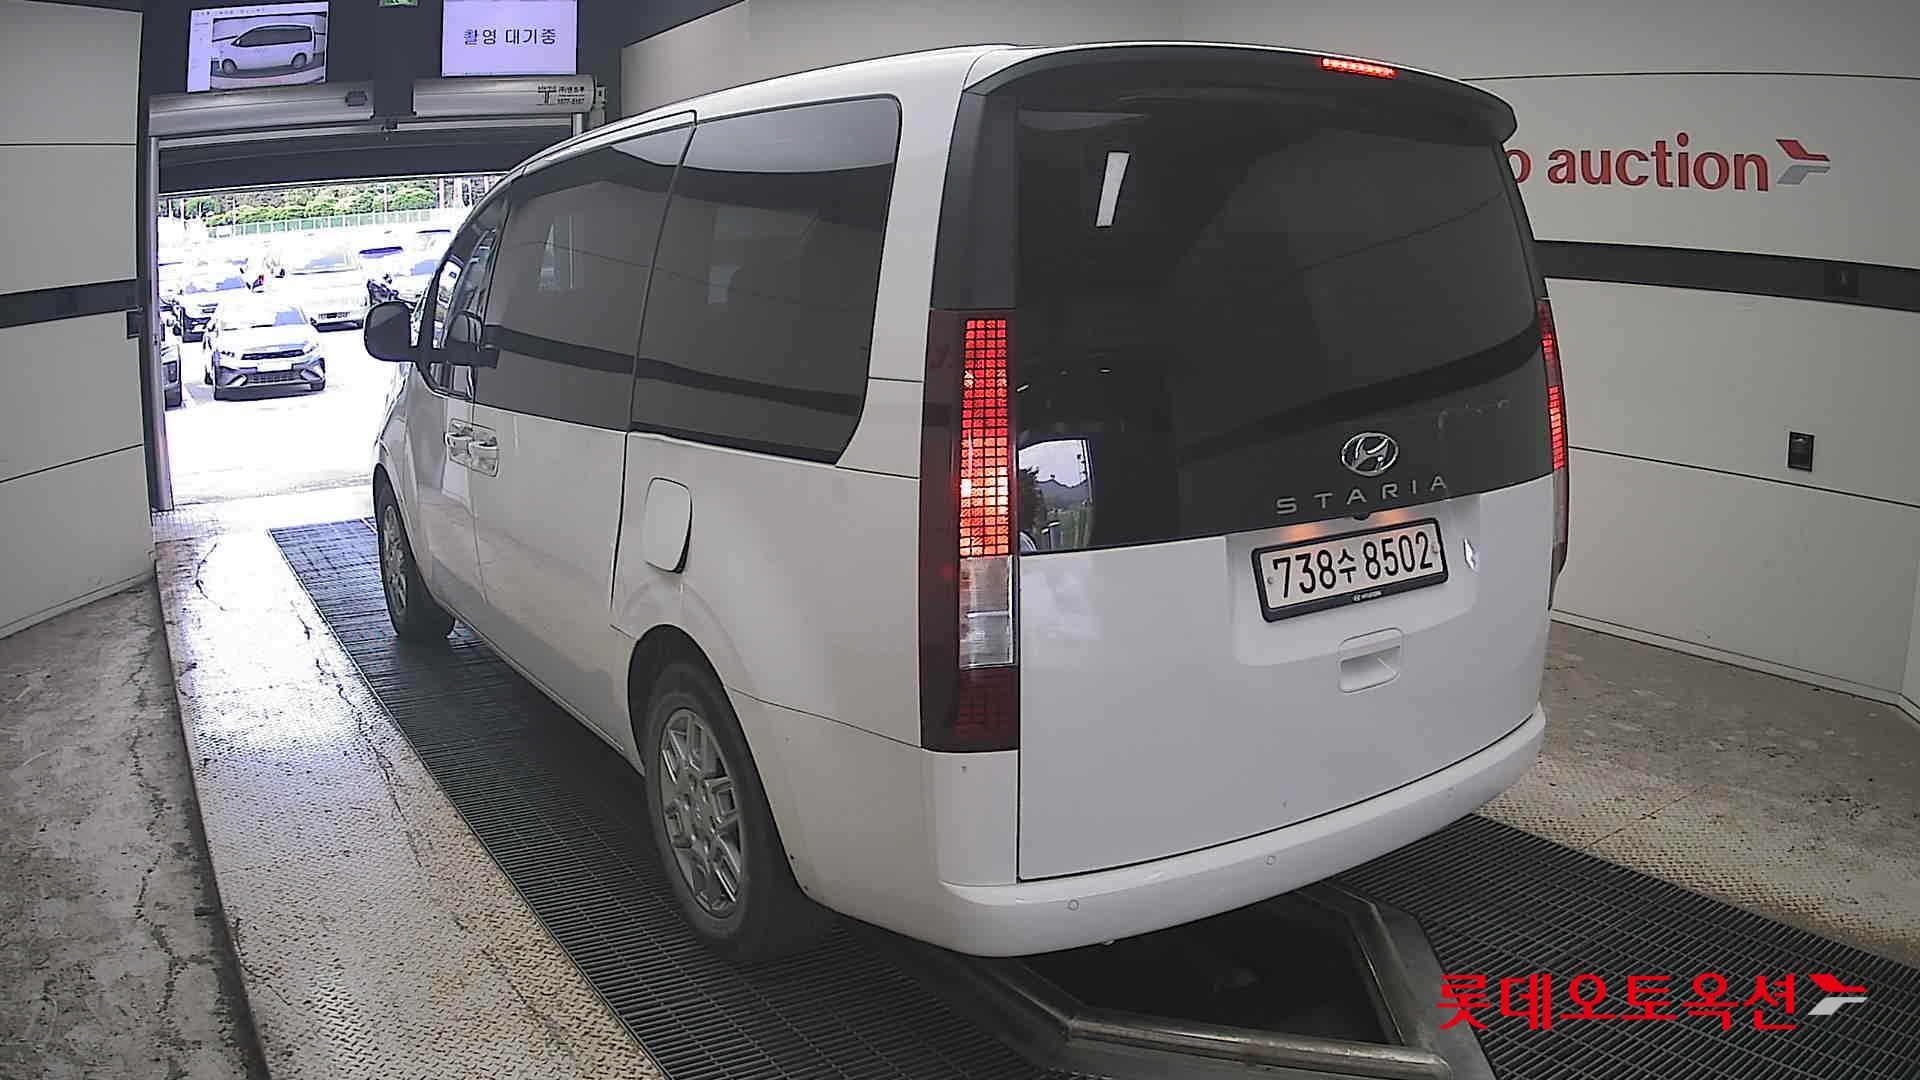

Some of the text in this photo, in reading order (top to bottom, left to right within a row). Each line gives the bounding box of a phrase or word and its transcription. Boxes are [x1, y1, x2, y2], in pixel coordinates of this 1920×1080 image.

[463, 28, 556, 46] 촬영 대기중
[1547, 131, 1769, 192] auction
[1275, 475, 1448, 515] STARIA
